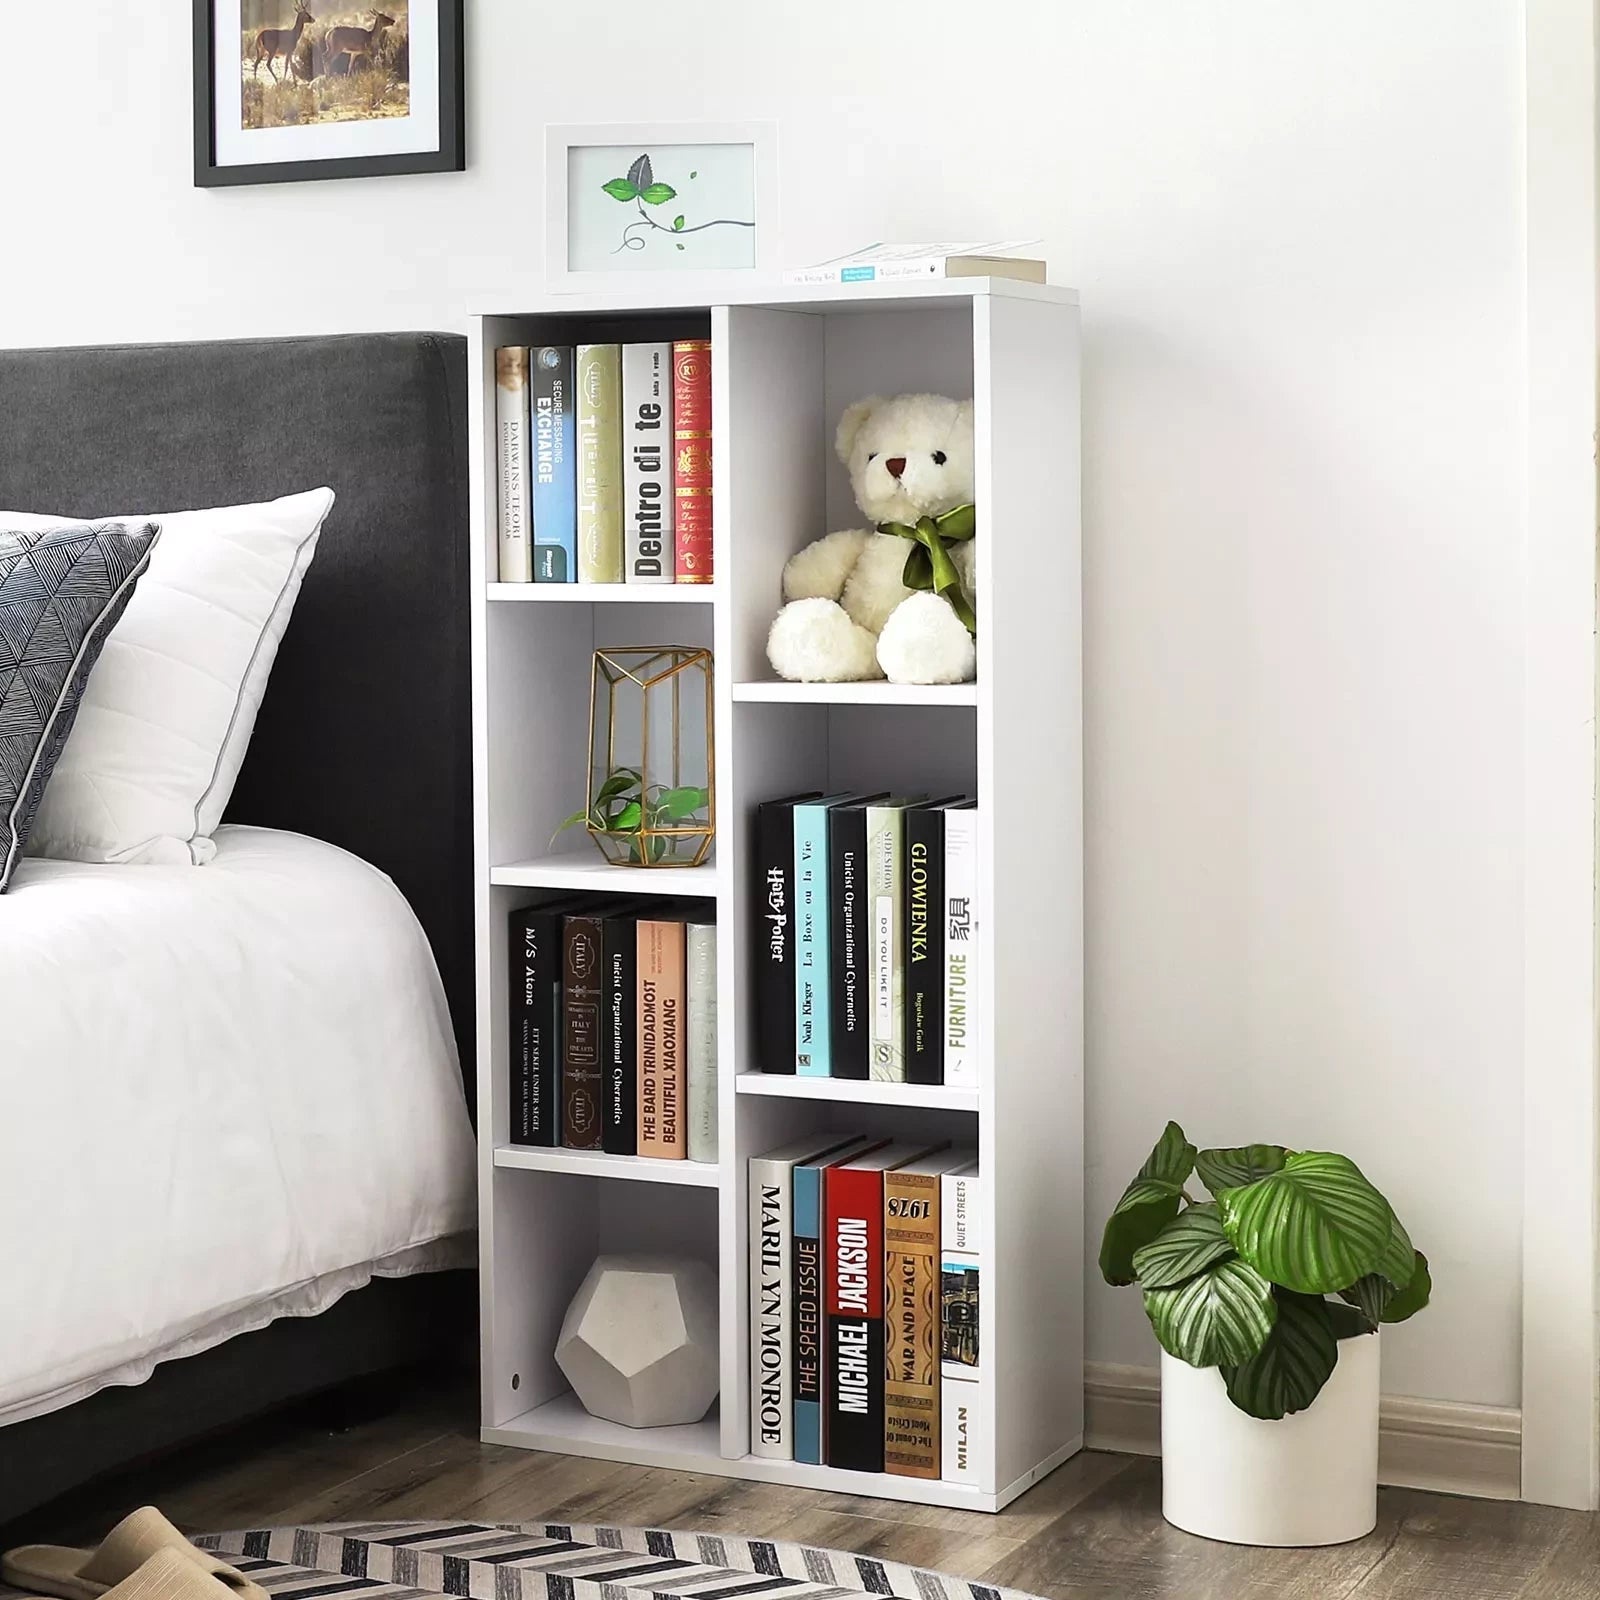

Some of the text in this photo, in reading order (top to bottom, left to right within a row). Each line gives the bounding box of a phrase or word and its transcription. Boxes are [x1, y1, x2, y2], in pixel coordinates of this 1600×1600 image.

[537, 397, 553, 483] EXCHANGE
[553, 379, 563, 463] SECURE MESSAGING
[510, 421, 520, 539] DARWINS TEORI
[633, 403, 662, 577] Dentro di te
[884, 831, 892, 890] SIDESHOW
[764, 866, 787, 963] Harry Potter
[802, 840, 812, 967] La Boxe ou la Vie
[880, 917, 888, 934] DO
[911, 842, 928, 963] GLOWIENKA
[525, 927, 538, 959] M/S
[575, 942, 586, 971] ITALY
[842, 852, 857, 1032] Unicist Organizational Cybernetics
[880, 939, 888, 963] YOU
[880, 966, 888, 992] LIKE
[948, 954, 966, 1049] FURNITURE
[571, 1020, 591, 1029] ITALY
[611, 954, 623, 1125] Unicist Organizational Cybernetics
[643, 980, 656, 1075] TRINIDADMOST
[802, 1020, 812, 1044] Noah
[643, 1078, 656, 1114] BARD
[662, 998, 676, 1144] BEAUTIFUL XIAOXIANG
[575, 1097, 586, 1125] ITALY
[643, 1116, 656, 1141] THE
[888, 1197, 930, 1219] 1978
[956, 1181, 966, 1248] QUIET STREETS
[760, 1184, 782, 1445] MARILYN MONROE
[799, 1242, 816, 1395] THE SPEED ISSUE
[837, 1217, 869, 1414] MICHAEL JACKSON
[902, 1256, 915, 1381] WAR AND PEACE
[887, 1416, 911, 1430] Cristo
[895, 1432, 917, 1446] Count
[918, 1435, 932, 1448] The
[957, 1407, 968, 1470] MILAN
